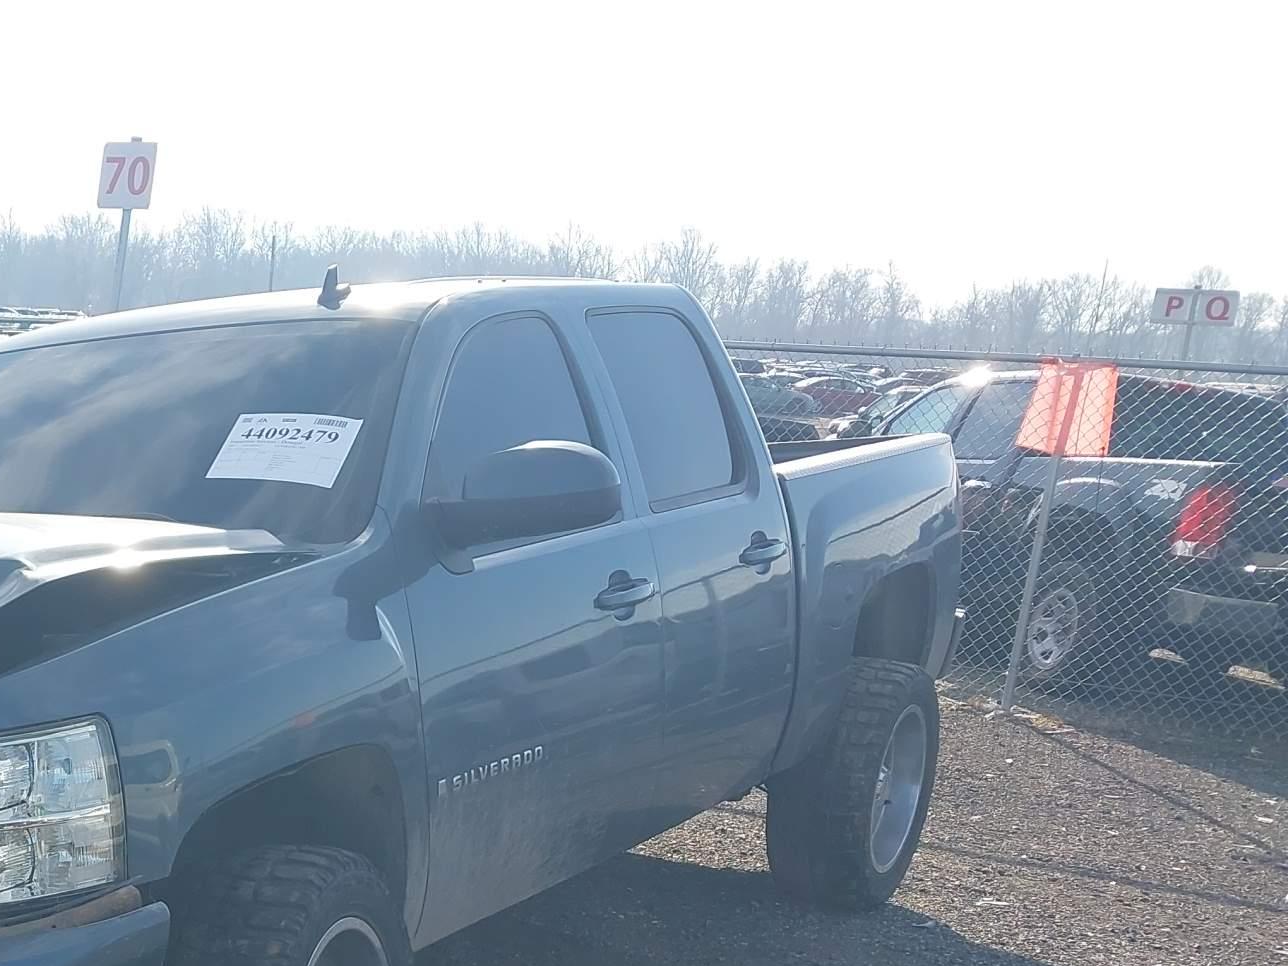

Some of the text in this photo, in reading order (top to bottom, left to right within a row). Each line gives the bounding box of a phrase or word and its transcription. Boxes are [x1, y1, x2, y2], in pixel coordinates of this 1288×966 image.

[105, 156, 150, 195] 70
[1165, 296, 1230, 320] P Q
[241, 427, 340, 444] 44092479
[453, 745, 543, 792] SILVERADO
